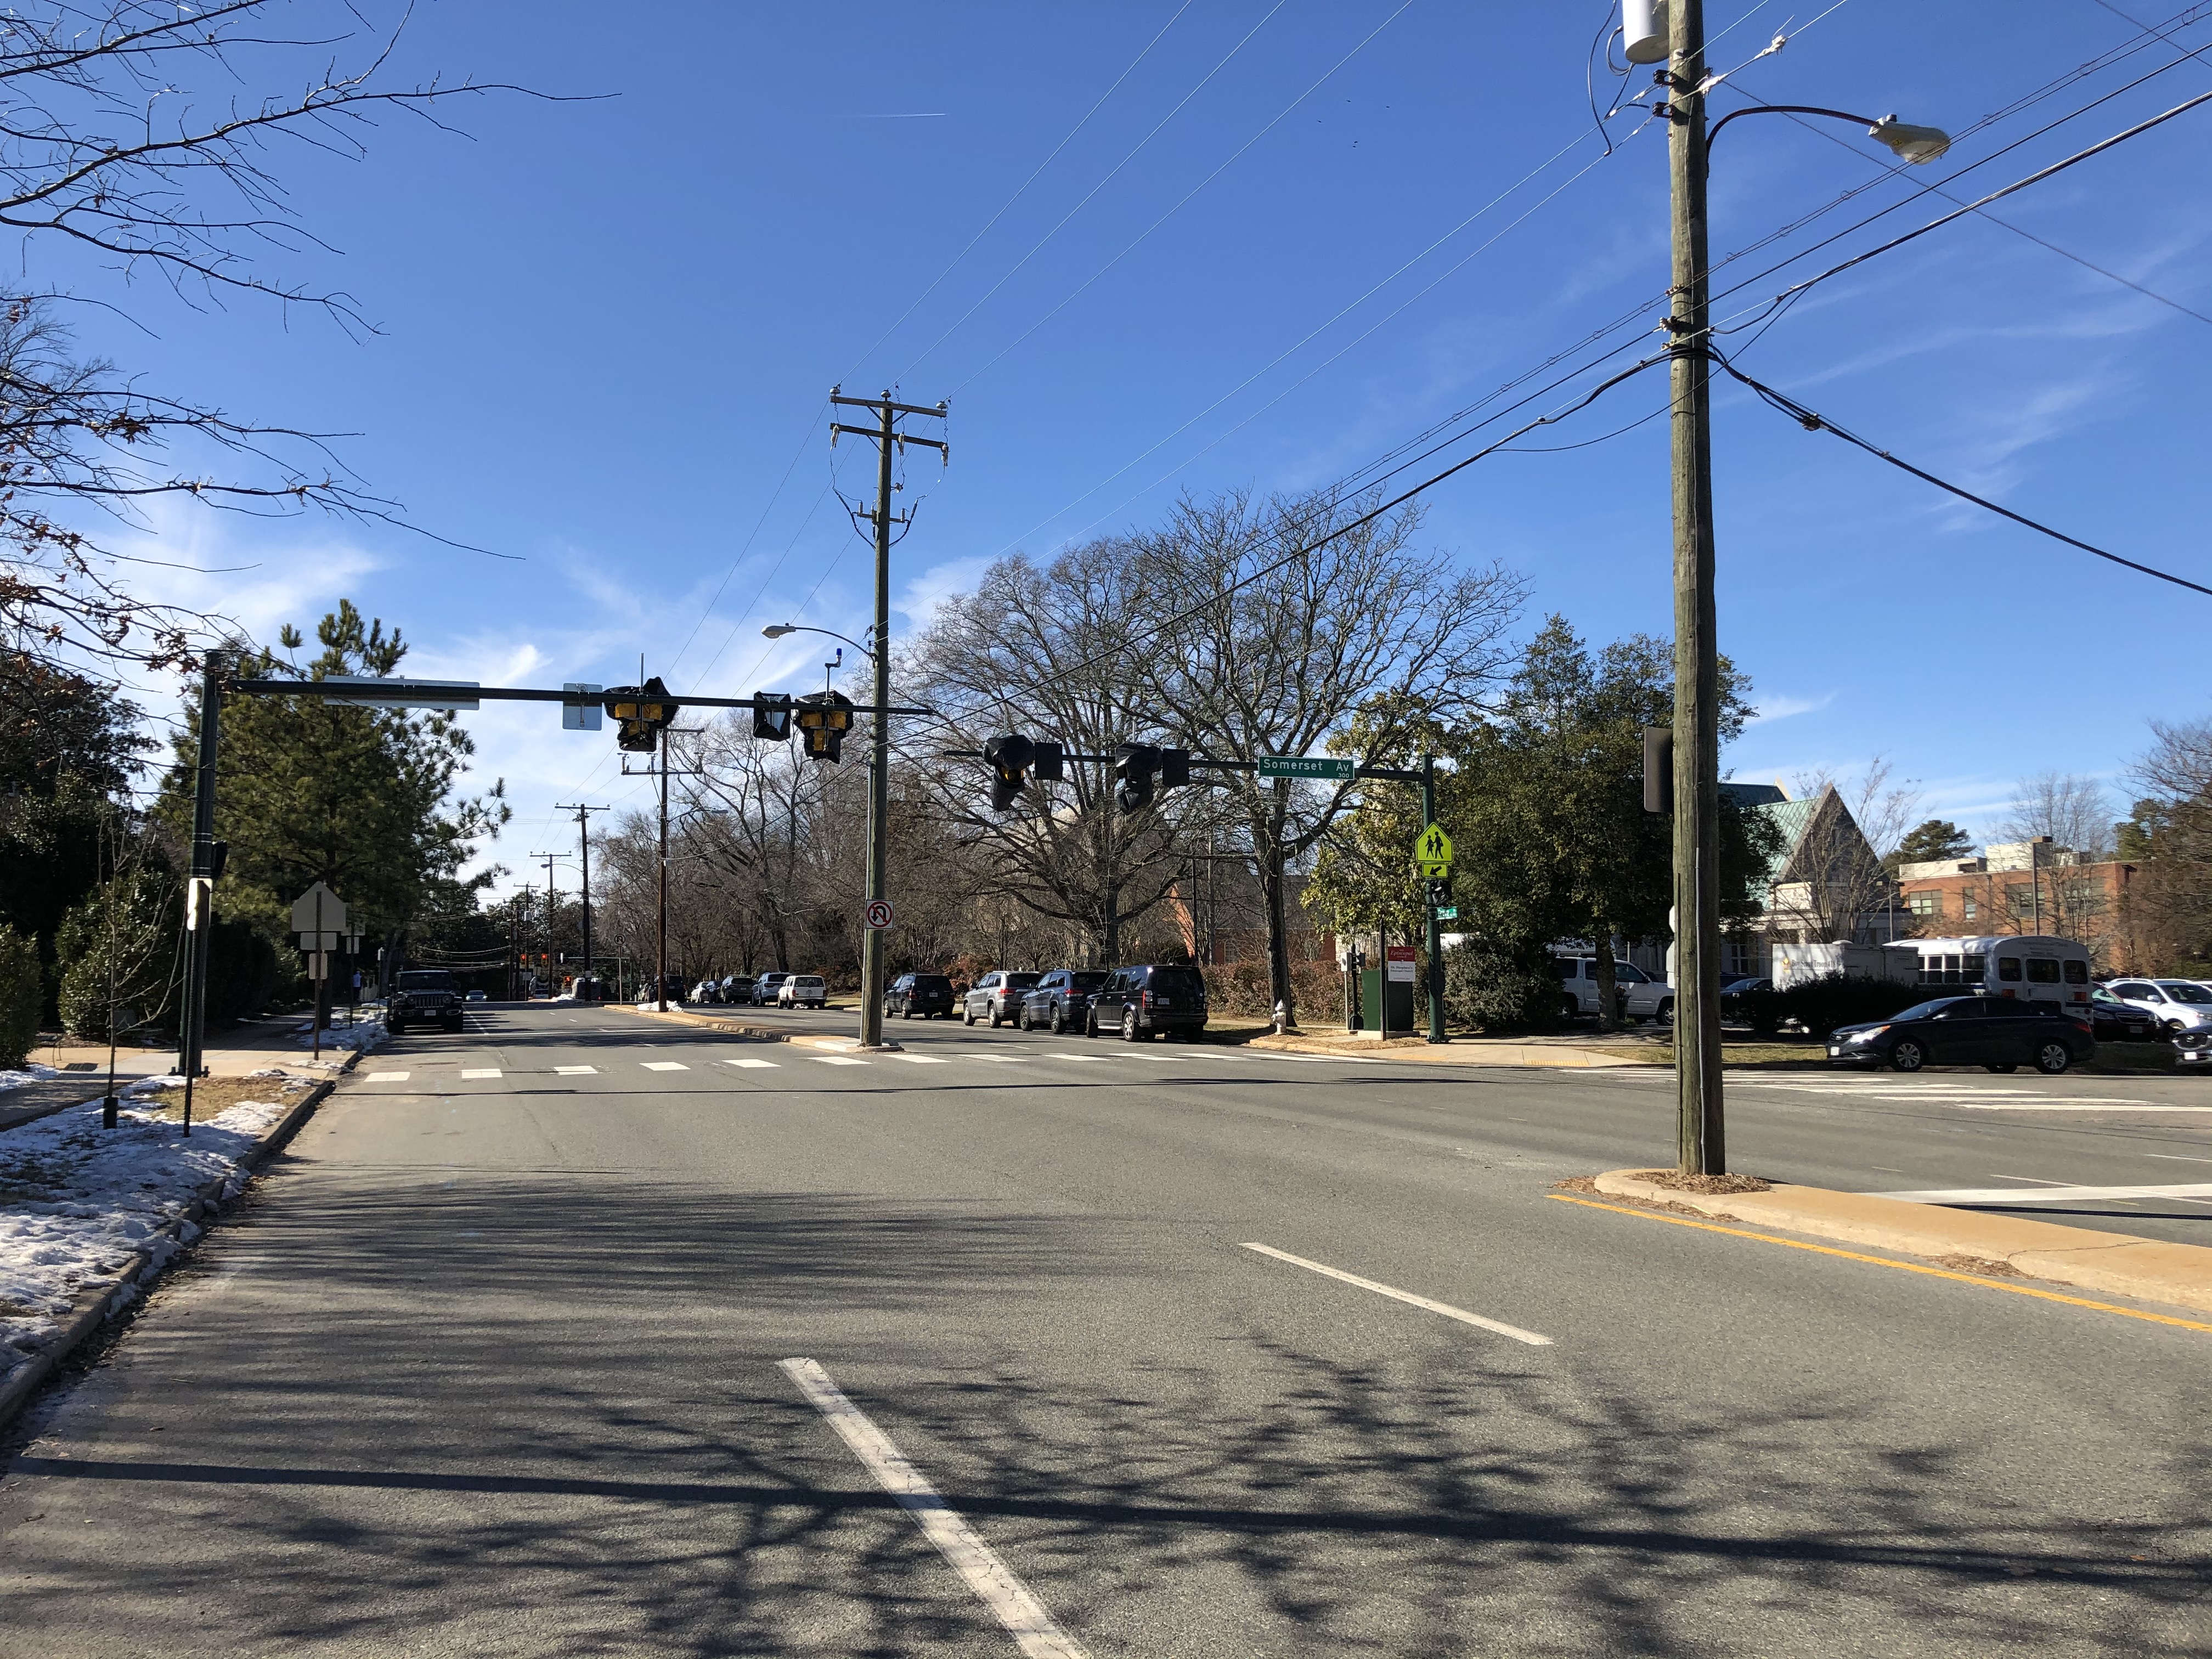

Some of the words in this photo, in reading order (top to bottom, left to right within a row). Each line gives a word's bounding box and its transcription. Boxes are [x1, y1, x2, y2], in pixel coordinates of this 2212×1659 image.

[1263, 758, 1323, 771] Somerset
[1336, 762, 1349, 772] Av
[1814, 960, 1827, 969] Troop
